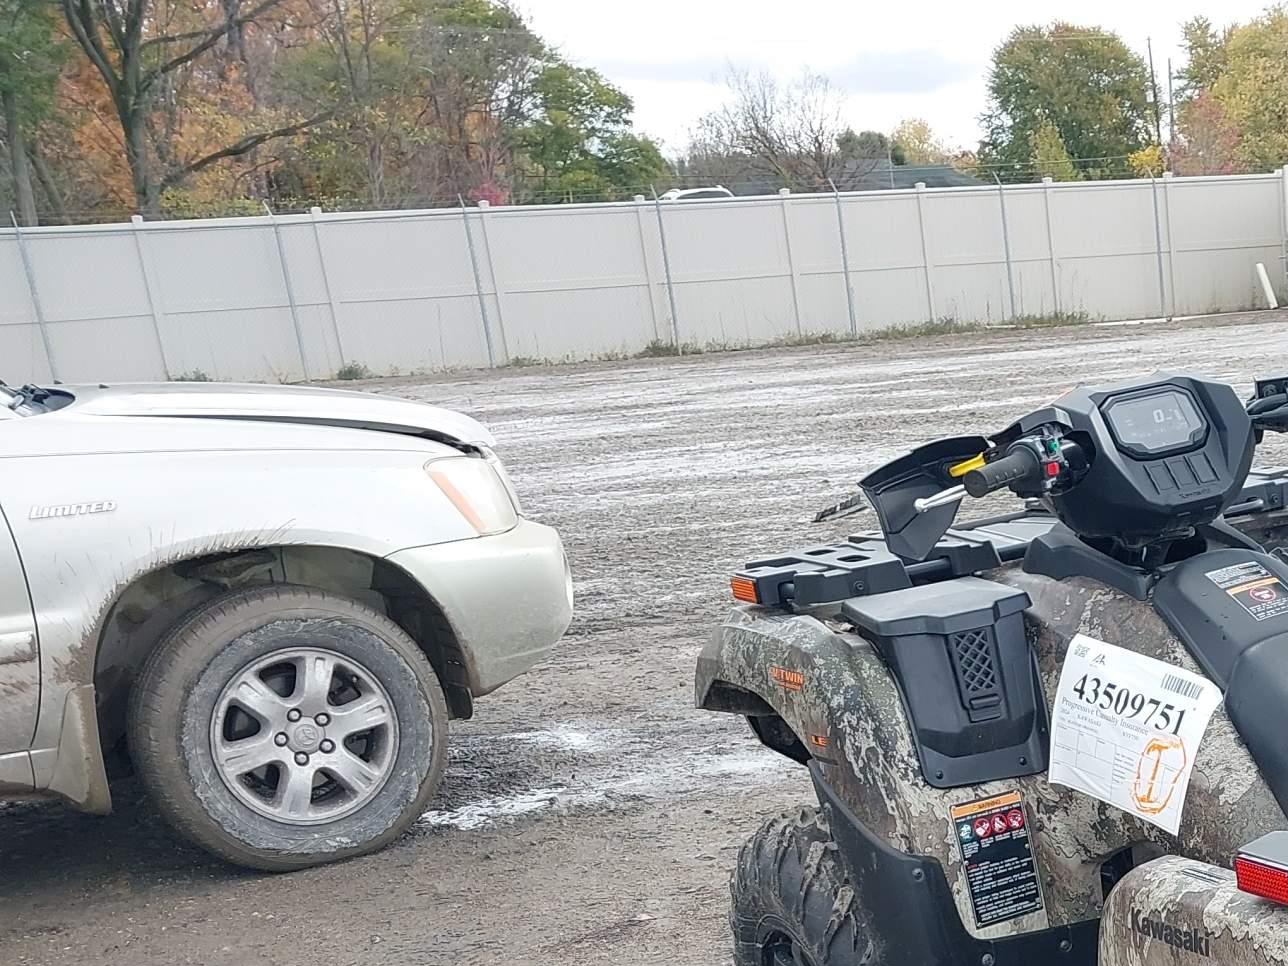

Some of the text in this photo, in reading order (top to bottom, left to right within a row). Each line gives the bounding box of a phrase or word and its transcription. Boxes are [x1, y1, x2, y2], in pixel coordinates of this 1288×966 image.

[29, 501, 117, 520] LIMITED
[1062, 697, 1095, 715] Progressive
[1119, 719, 1149, 736] Insurance
[1073, 673, 1187, 737] 43509751
[1130, 906, 1210, 957] Kawasaki
